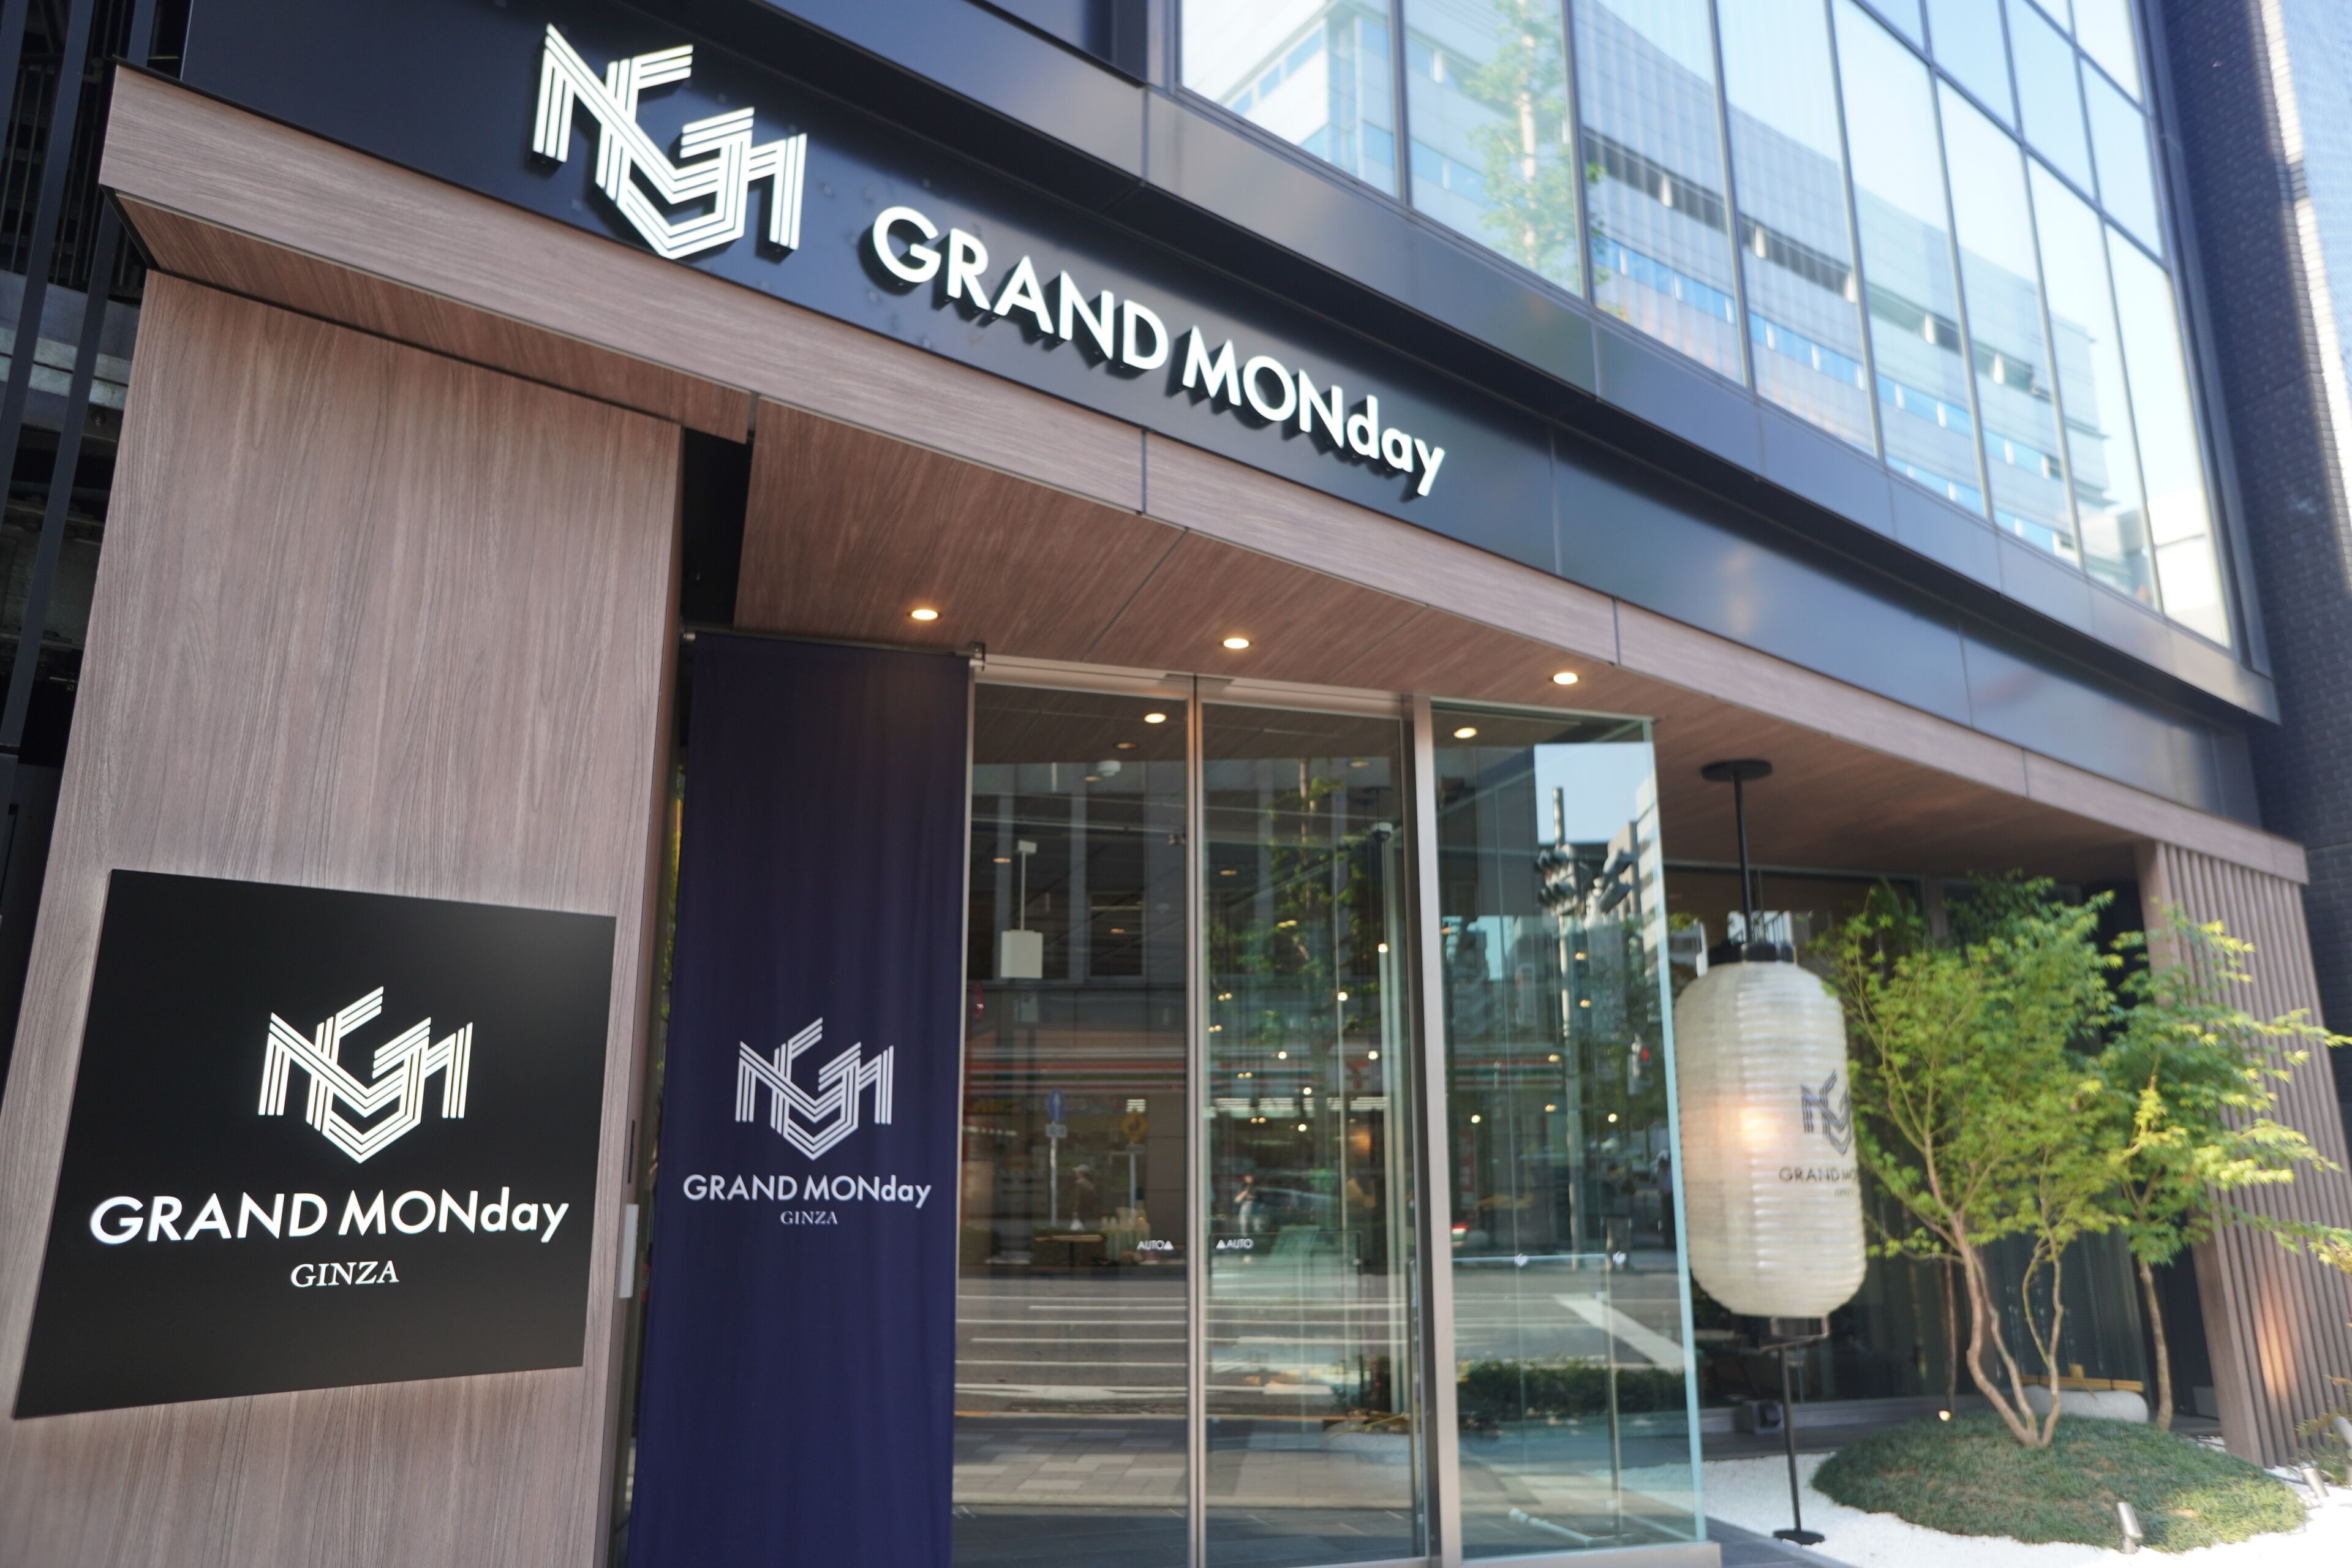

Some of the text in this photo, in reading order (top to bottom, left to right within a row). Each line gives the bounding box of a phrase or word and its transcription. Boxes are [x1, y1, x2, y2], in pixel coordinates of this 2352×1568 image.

[872, 205, 1446, 497] GRAND MONday
[1779, 1166, 1839, 1182] GRAND
[682, 1174, 932, 1210] GRAND MONday
[89, 1186, 570, 1245] GRAND MONday
[780, 1210, 839, 1225] GINZA
[1137, 1240, 1164, 1250] AUTO
[1226, 1238, 1254, 1250] AUTO
[290, 1259, 401, 1289] GINZA
